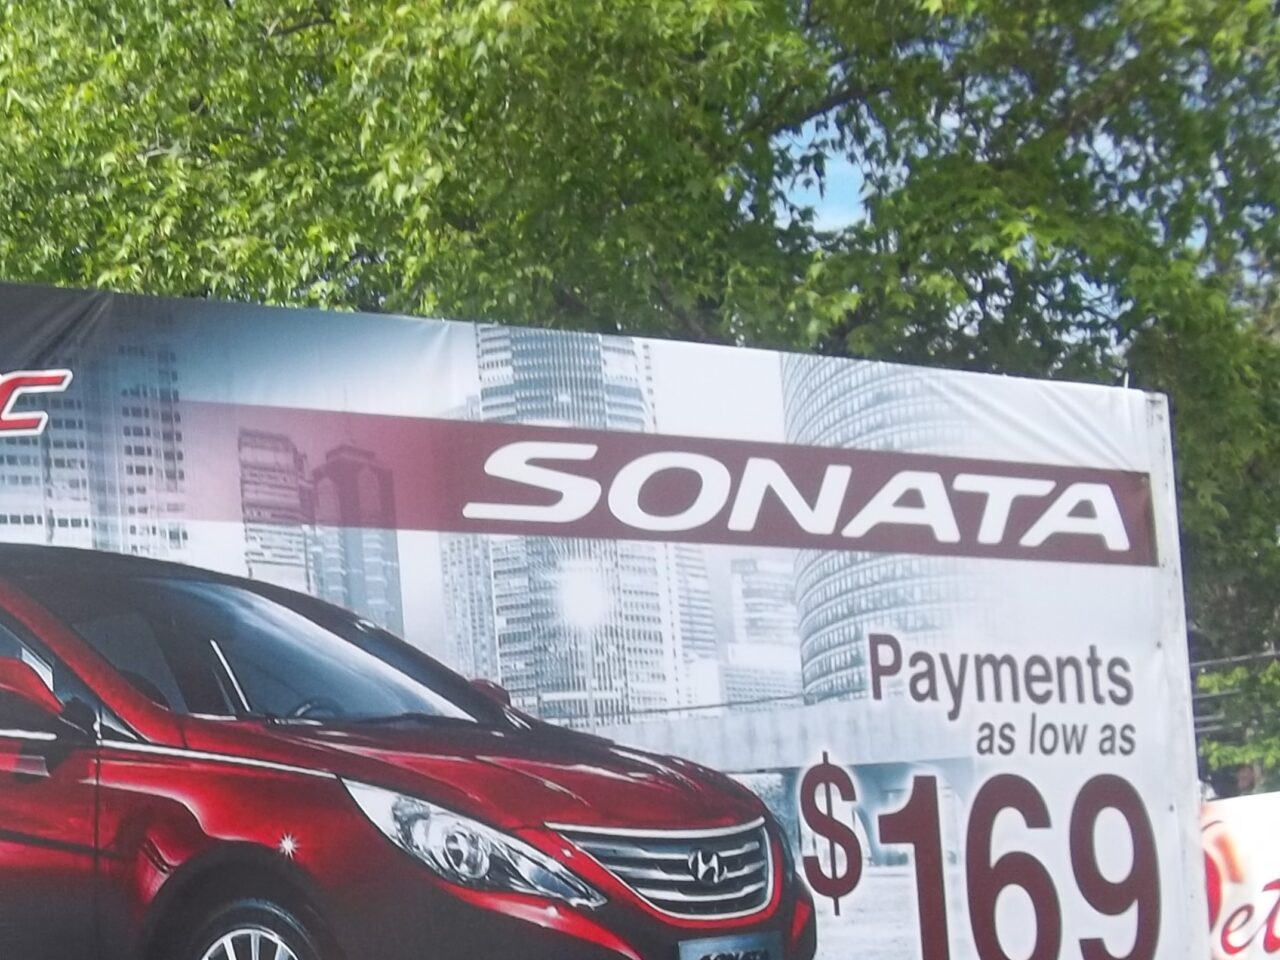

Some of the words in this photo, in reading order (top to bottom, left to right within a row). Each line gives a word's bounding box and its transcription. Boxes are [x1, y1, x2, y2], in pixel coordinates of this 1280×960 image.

[462, 441, 1131, 551] SONATA
[868, 633, 1133, 721] Payments
[977, 718, 1015, 756] as
[1029, 713, 1087, 755] low
[1100, 717, 1136, 755] as
